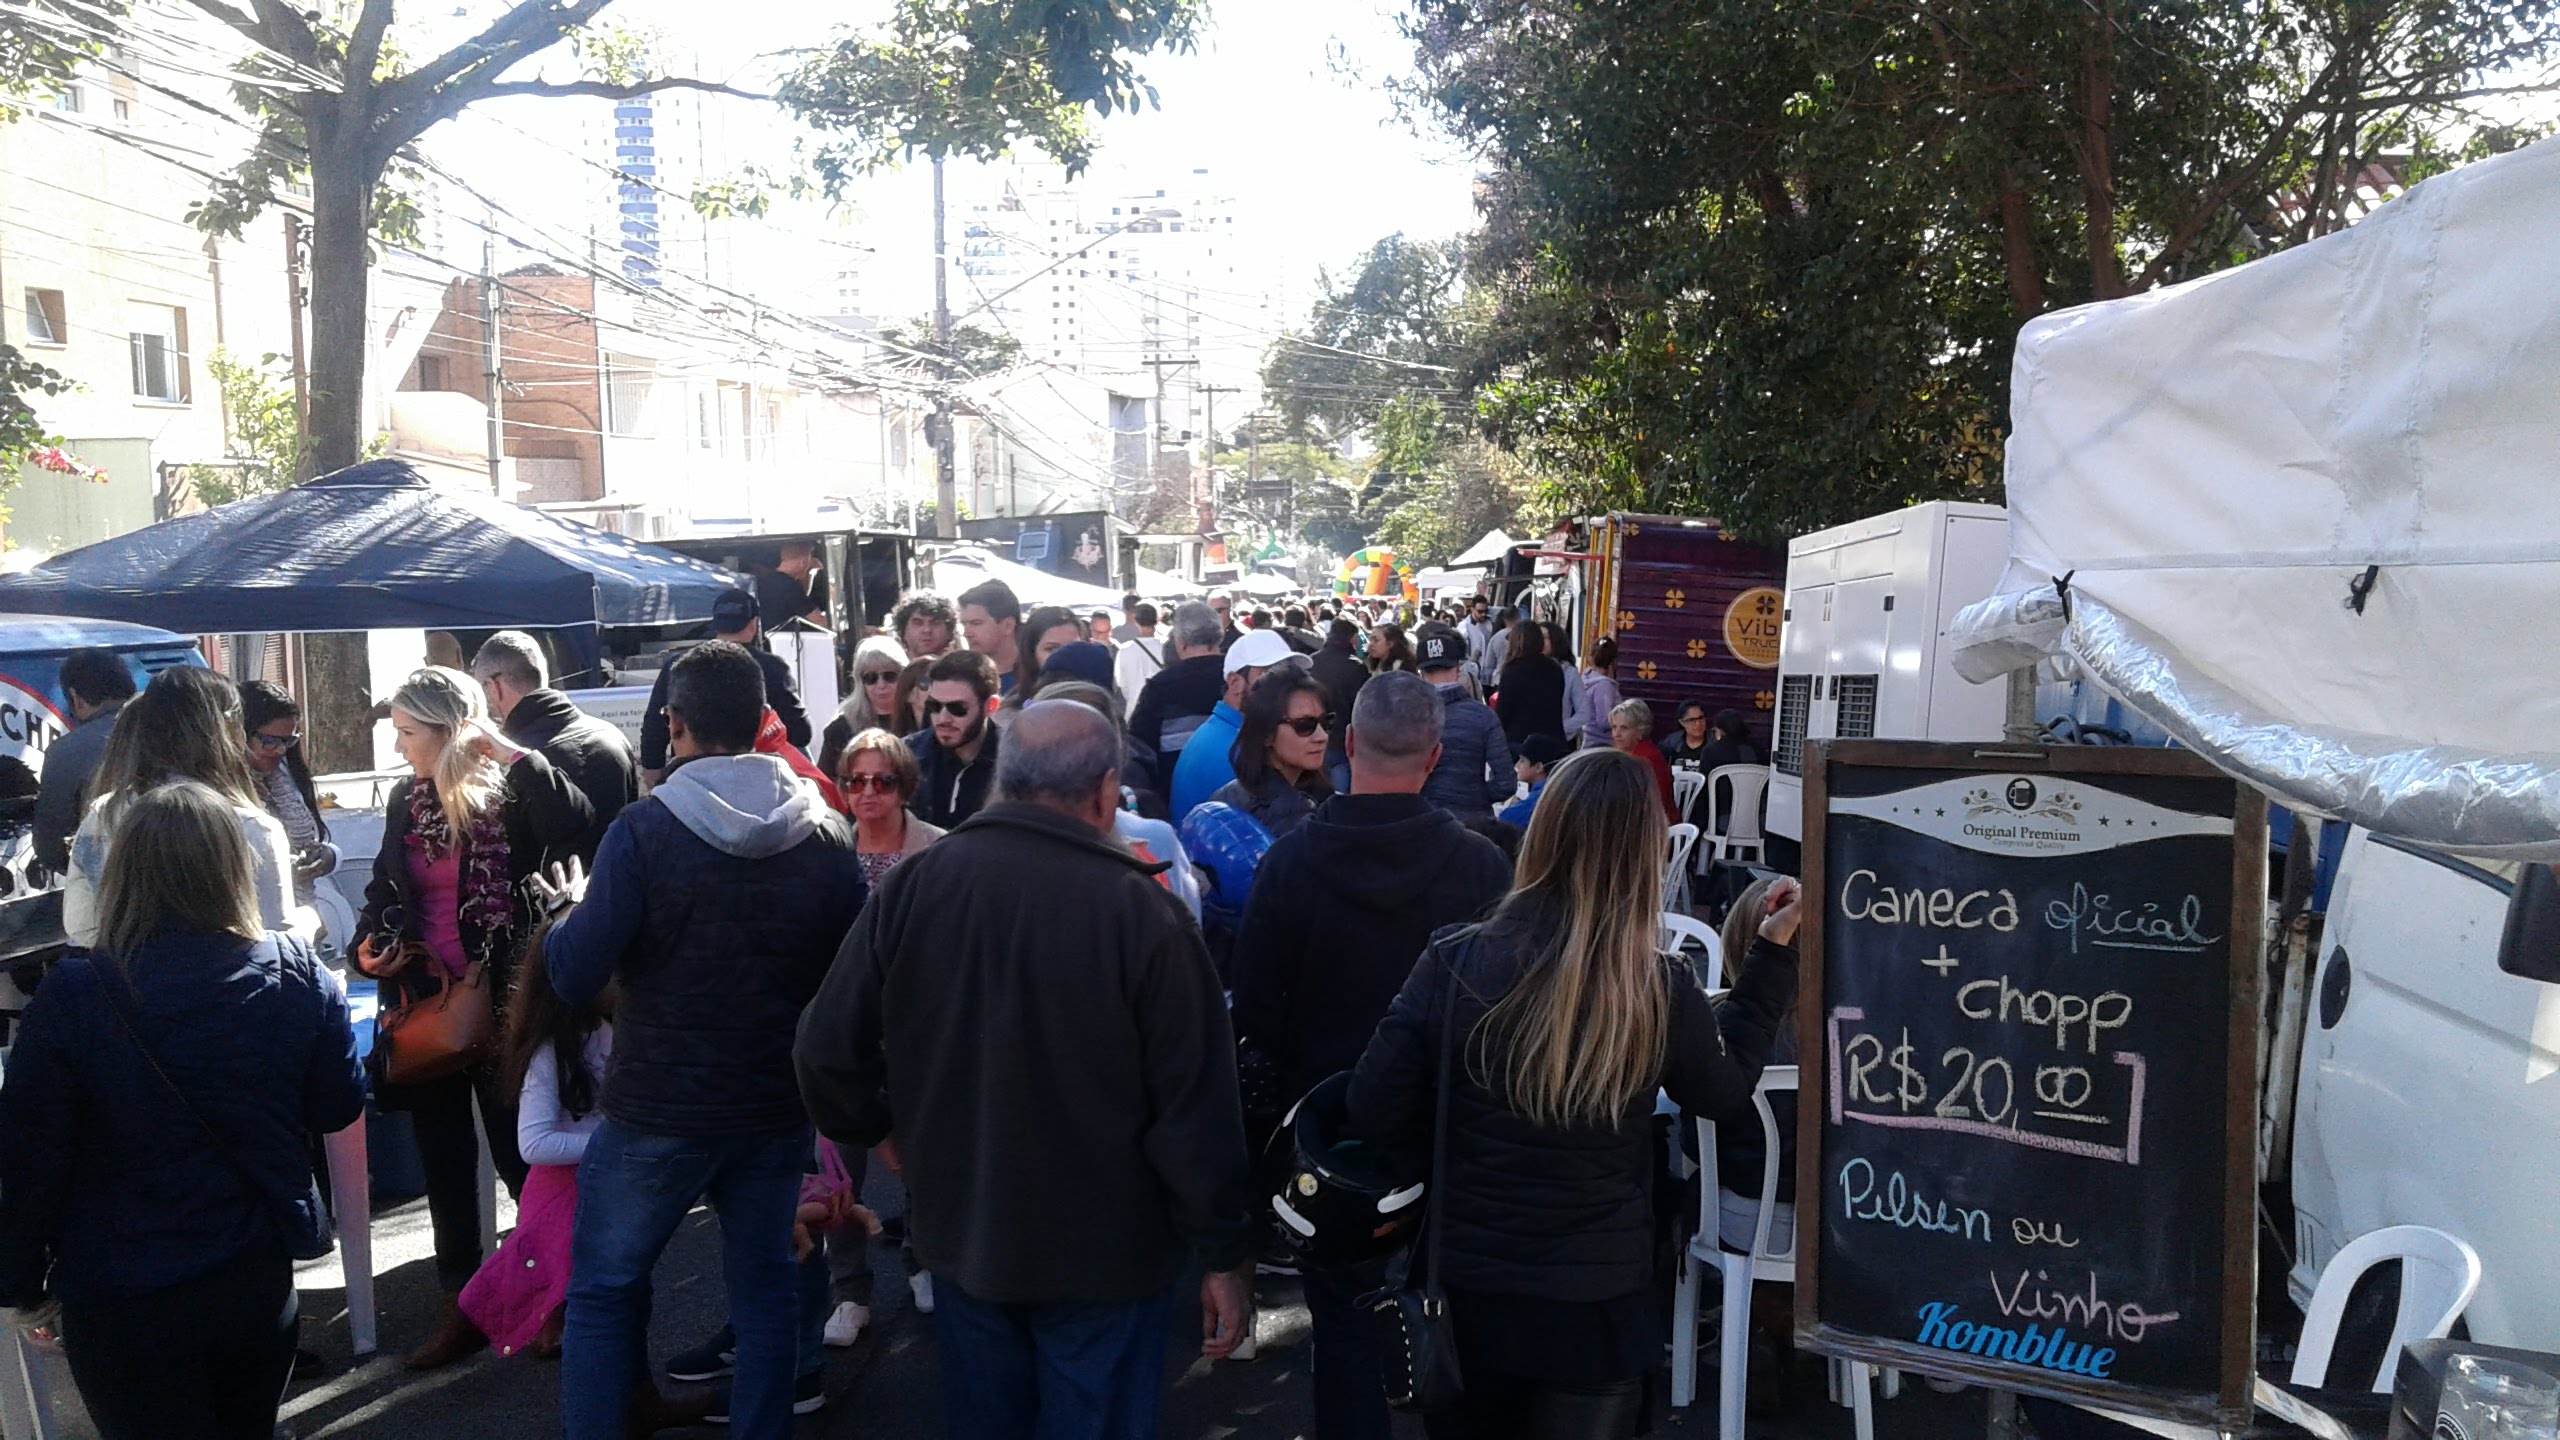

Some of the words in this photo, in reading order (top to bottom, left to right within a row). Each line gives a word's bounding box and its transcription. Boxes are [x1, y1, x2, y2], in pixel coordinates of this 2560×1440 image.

[1736, 617, 1779, 637] Vib
[1741, 637, 1780, 649] TRUC
[1963, 823, 2016, 840] Original
[2021, 826, 2080, 842] Premium
[1841, 868, 2020, 932] Caneca
[2045, 881, 2221, 954] oficial
[1957, 974, 2132, 1054] Chopp
[2012, 1217, 2079, 1249] ou
[1989, 1268, 2181, 1343] Vinho
[1917, 1300, 2117, 1378] Komblue
